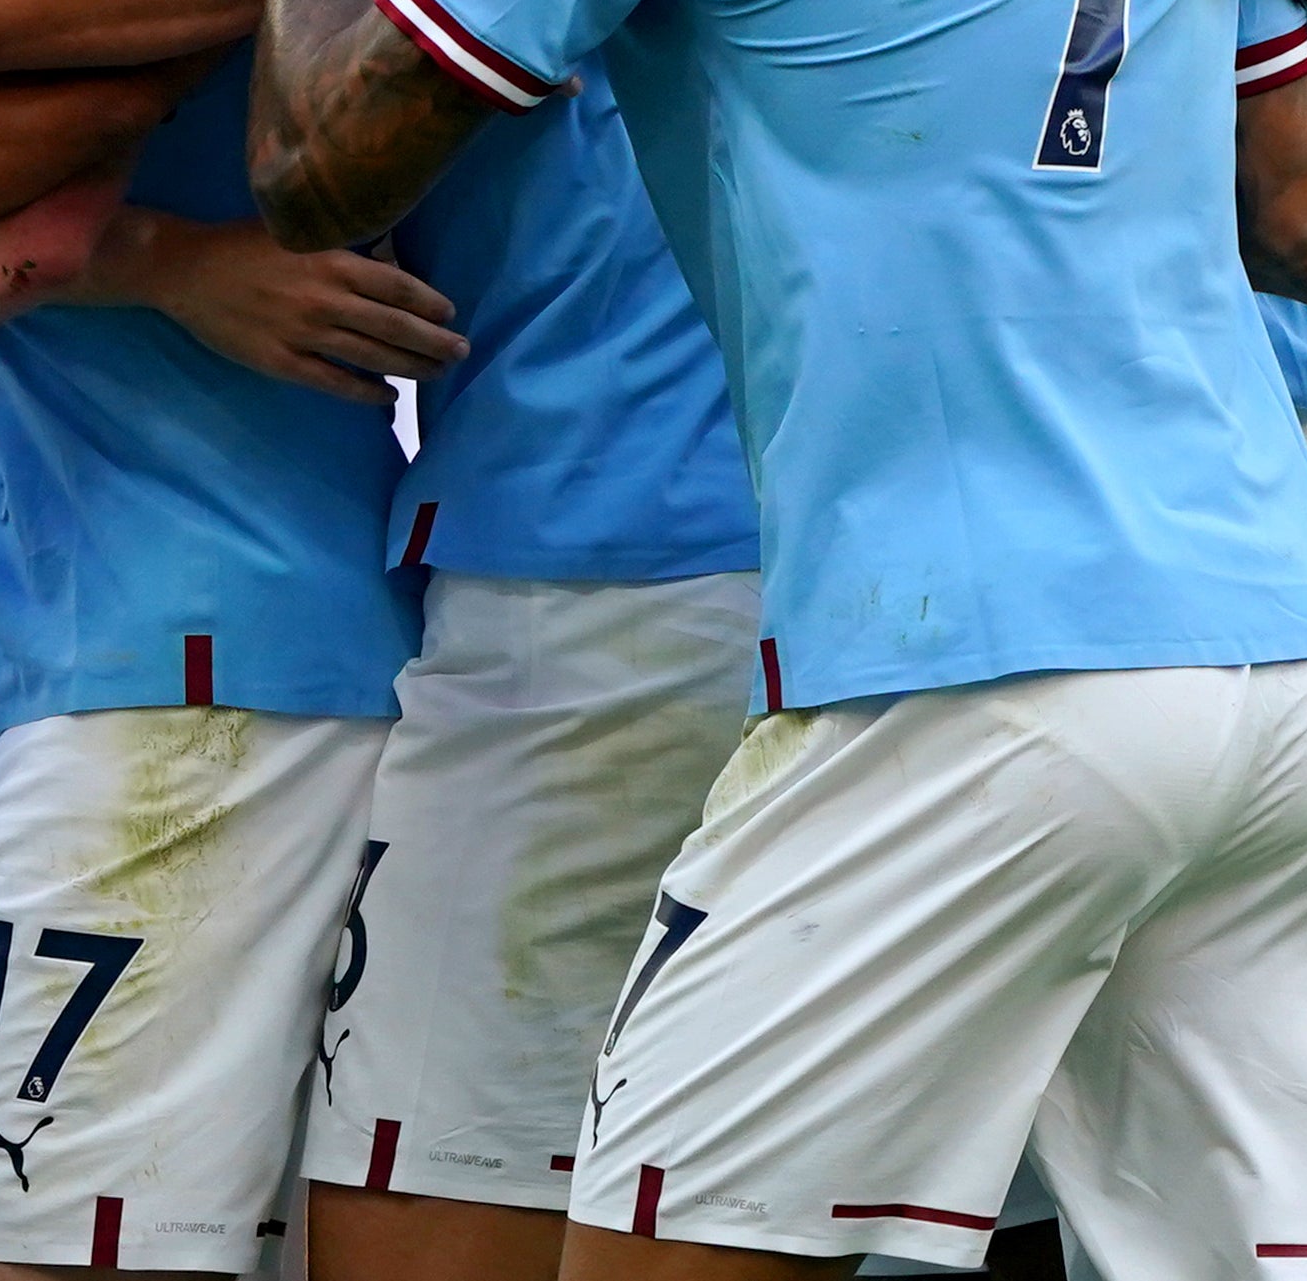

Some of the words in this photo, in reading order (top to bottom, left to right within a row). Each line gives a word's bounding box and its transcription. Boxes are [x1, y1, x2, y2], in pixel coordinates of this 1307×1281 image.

[602, 890, 709, 1058] 7
[428, 1149, 507, 1170] ULTRAWEAVE
[694, 1192, 768, 1214] ULTRAWEAVE
[154, 1222, 227, 1236] ULTRAWEAVE
